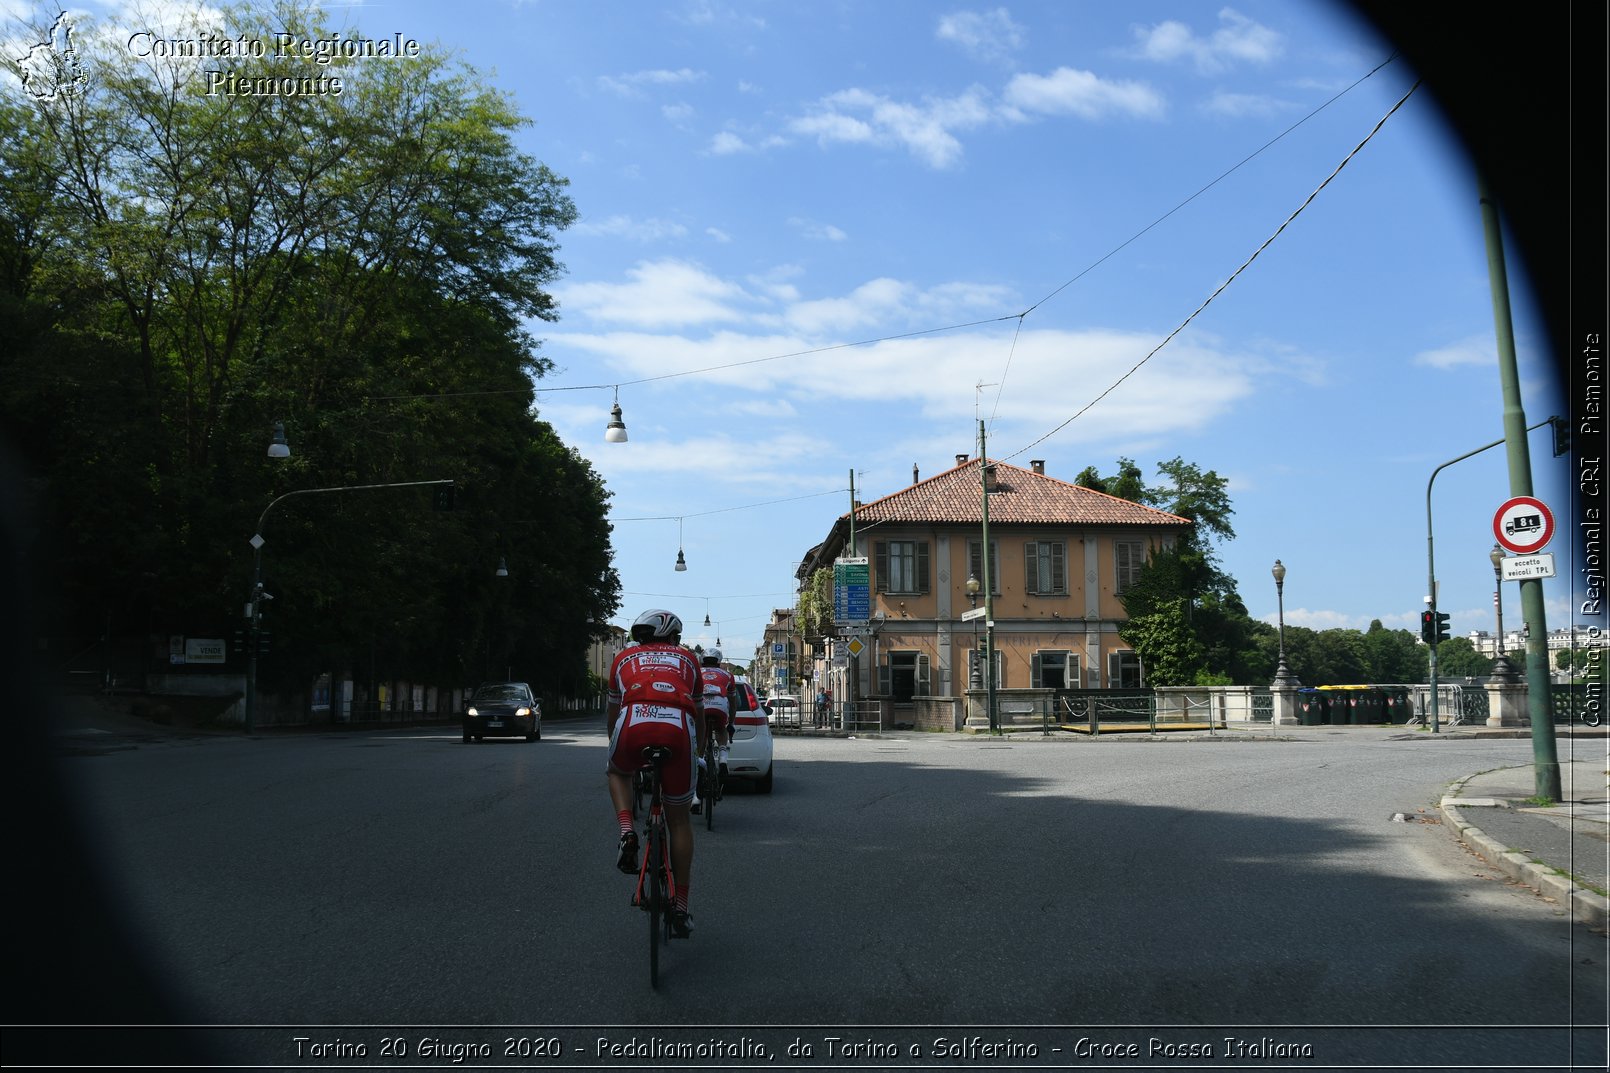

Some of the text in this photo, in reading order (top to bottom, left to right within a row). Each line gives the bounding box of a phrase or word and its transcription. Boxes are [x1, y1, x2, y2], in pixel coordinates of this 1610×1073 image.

[1520, 517, 1527, 527] 8
[1514, 558, 1541, 567] eccetto
[1536, 567, 1549, 575] TPL
